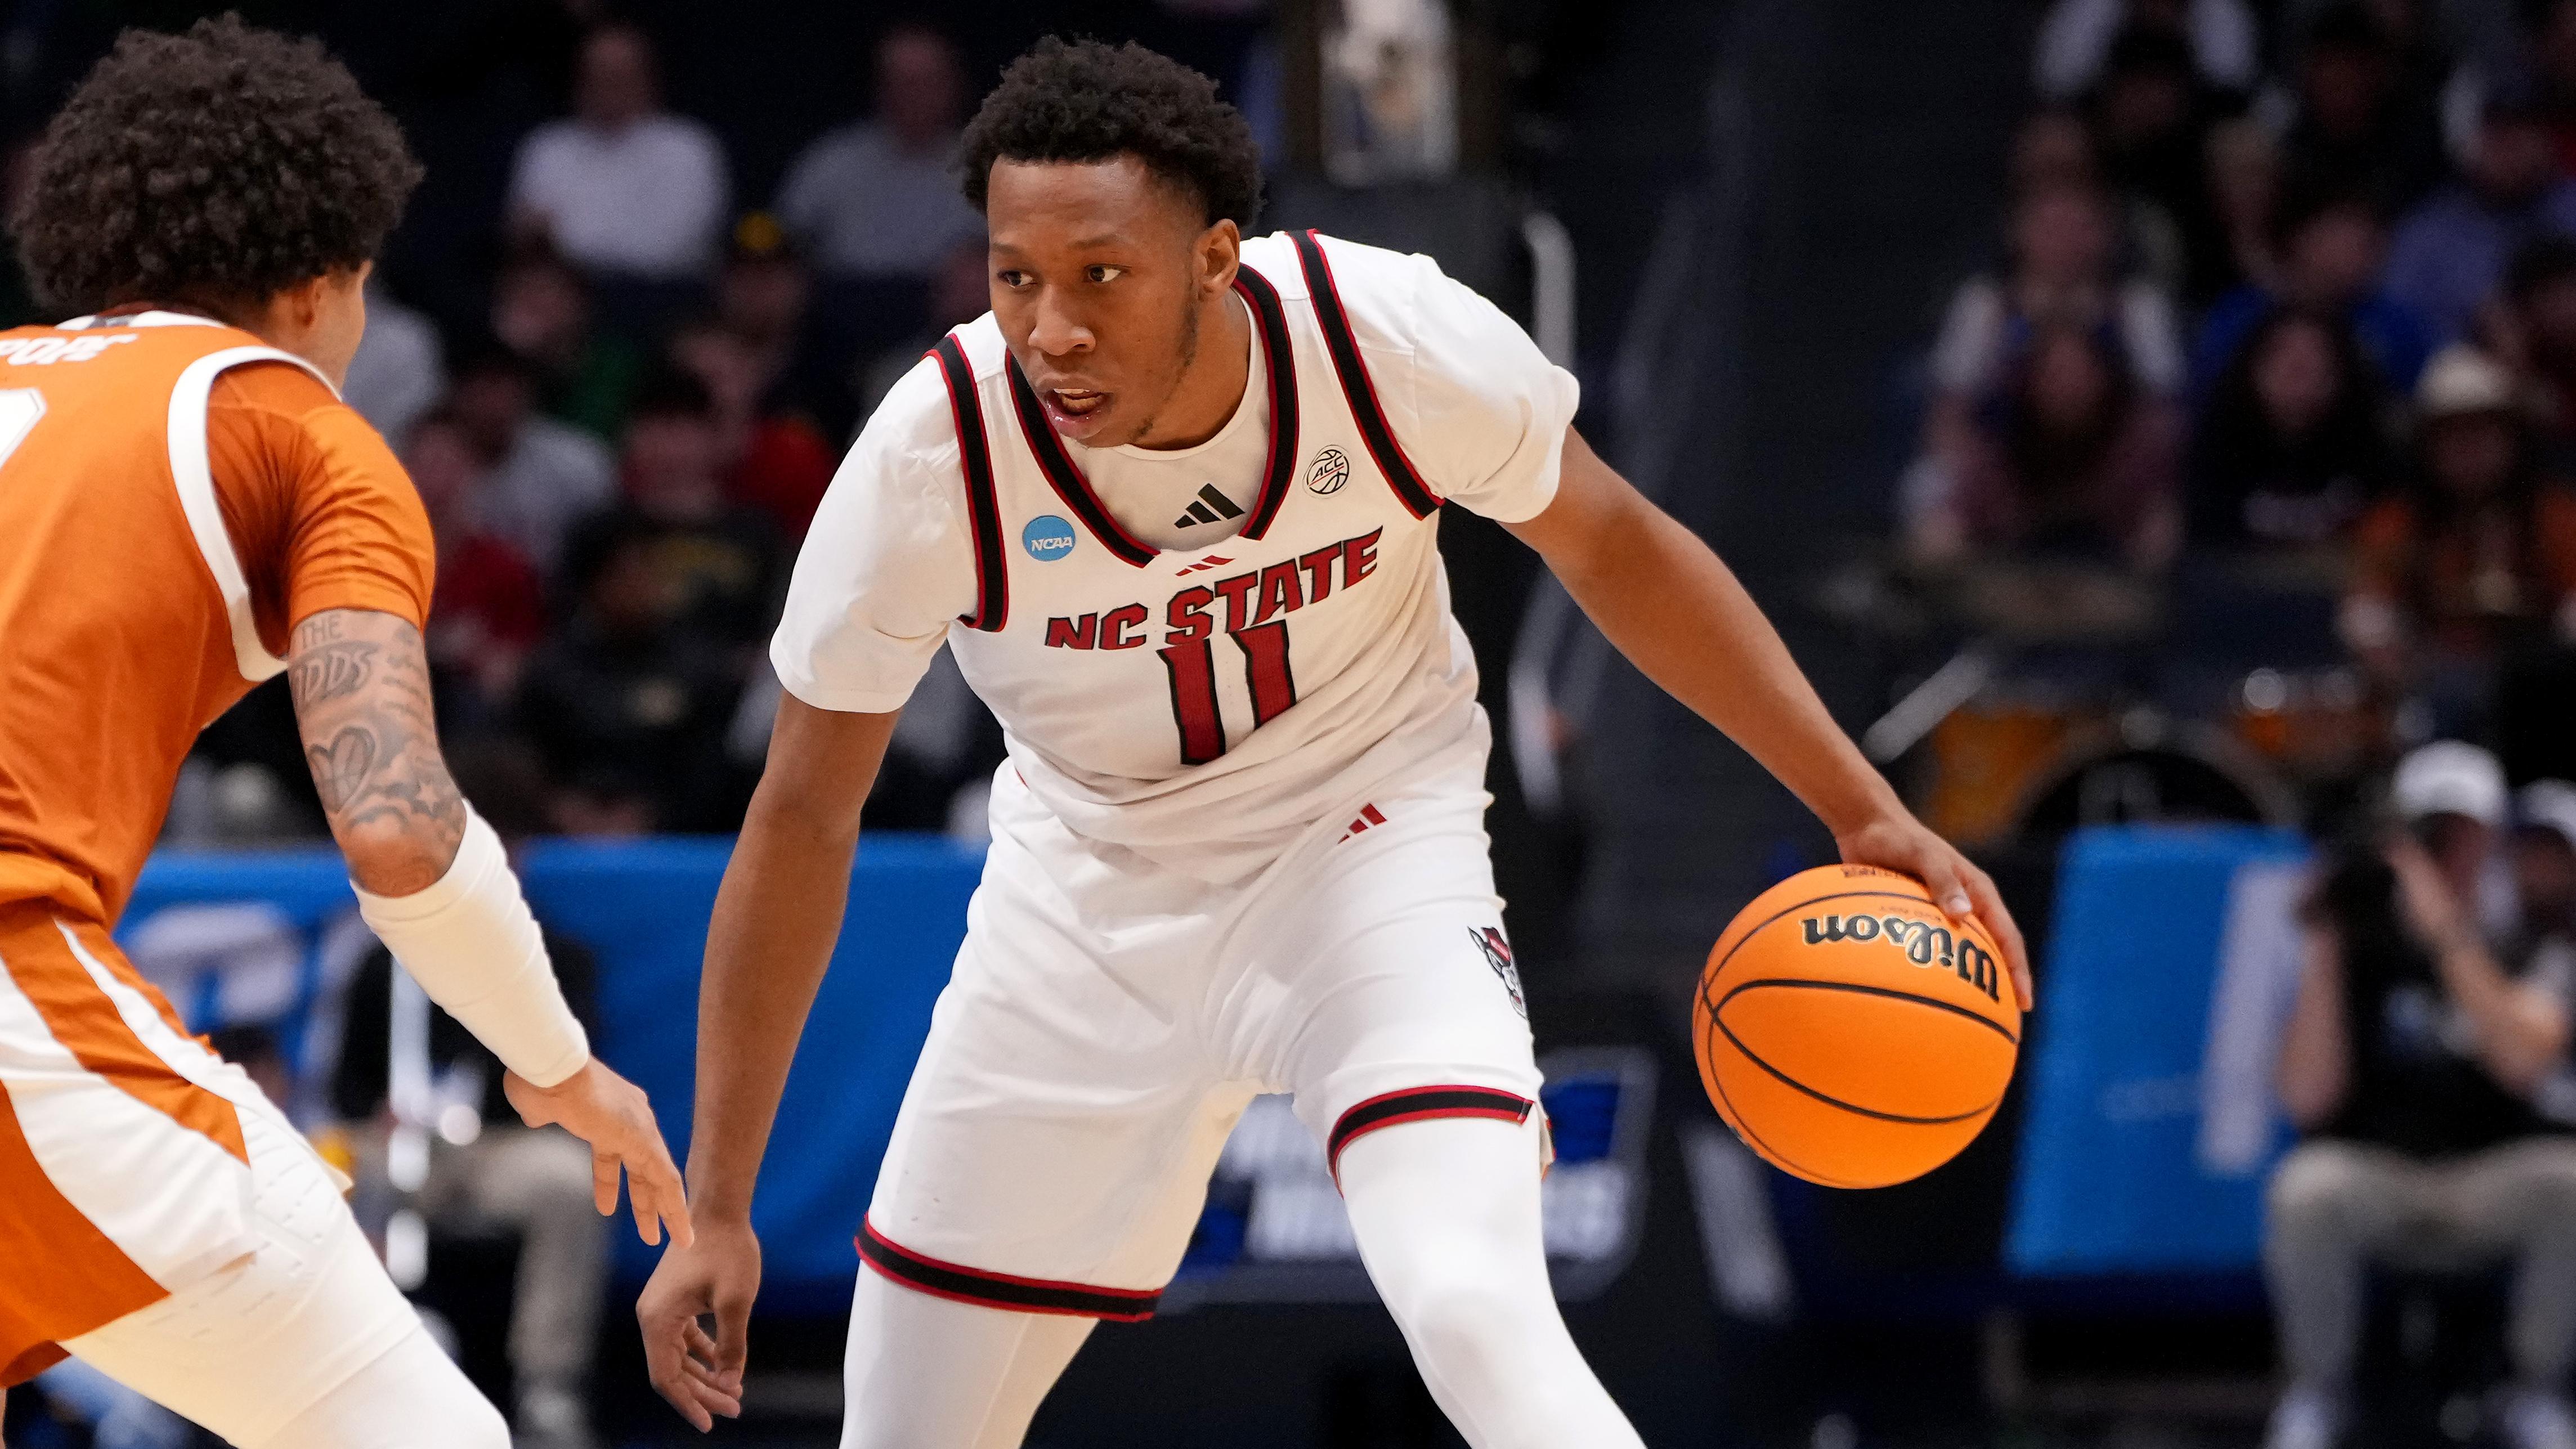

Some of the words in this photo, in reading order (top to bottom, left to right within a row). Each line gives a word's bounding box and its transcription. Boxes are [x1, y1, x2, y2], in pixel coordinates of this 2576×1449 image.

[1311, 454, 1345, 482] ACC
[1031, 536, 1073, 552] NCAA
[1045, 603, 1148, 650] NC
[1164, 525, 1383, 645] STATE
[1156, 619, 1297, 765] 11
[1801, 914, 2000, 1003] Wilson
